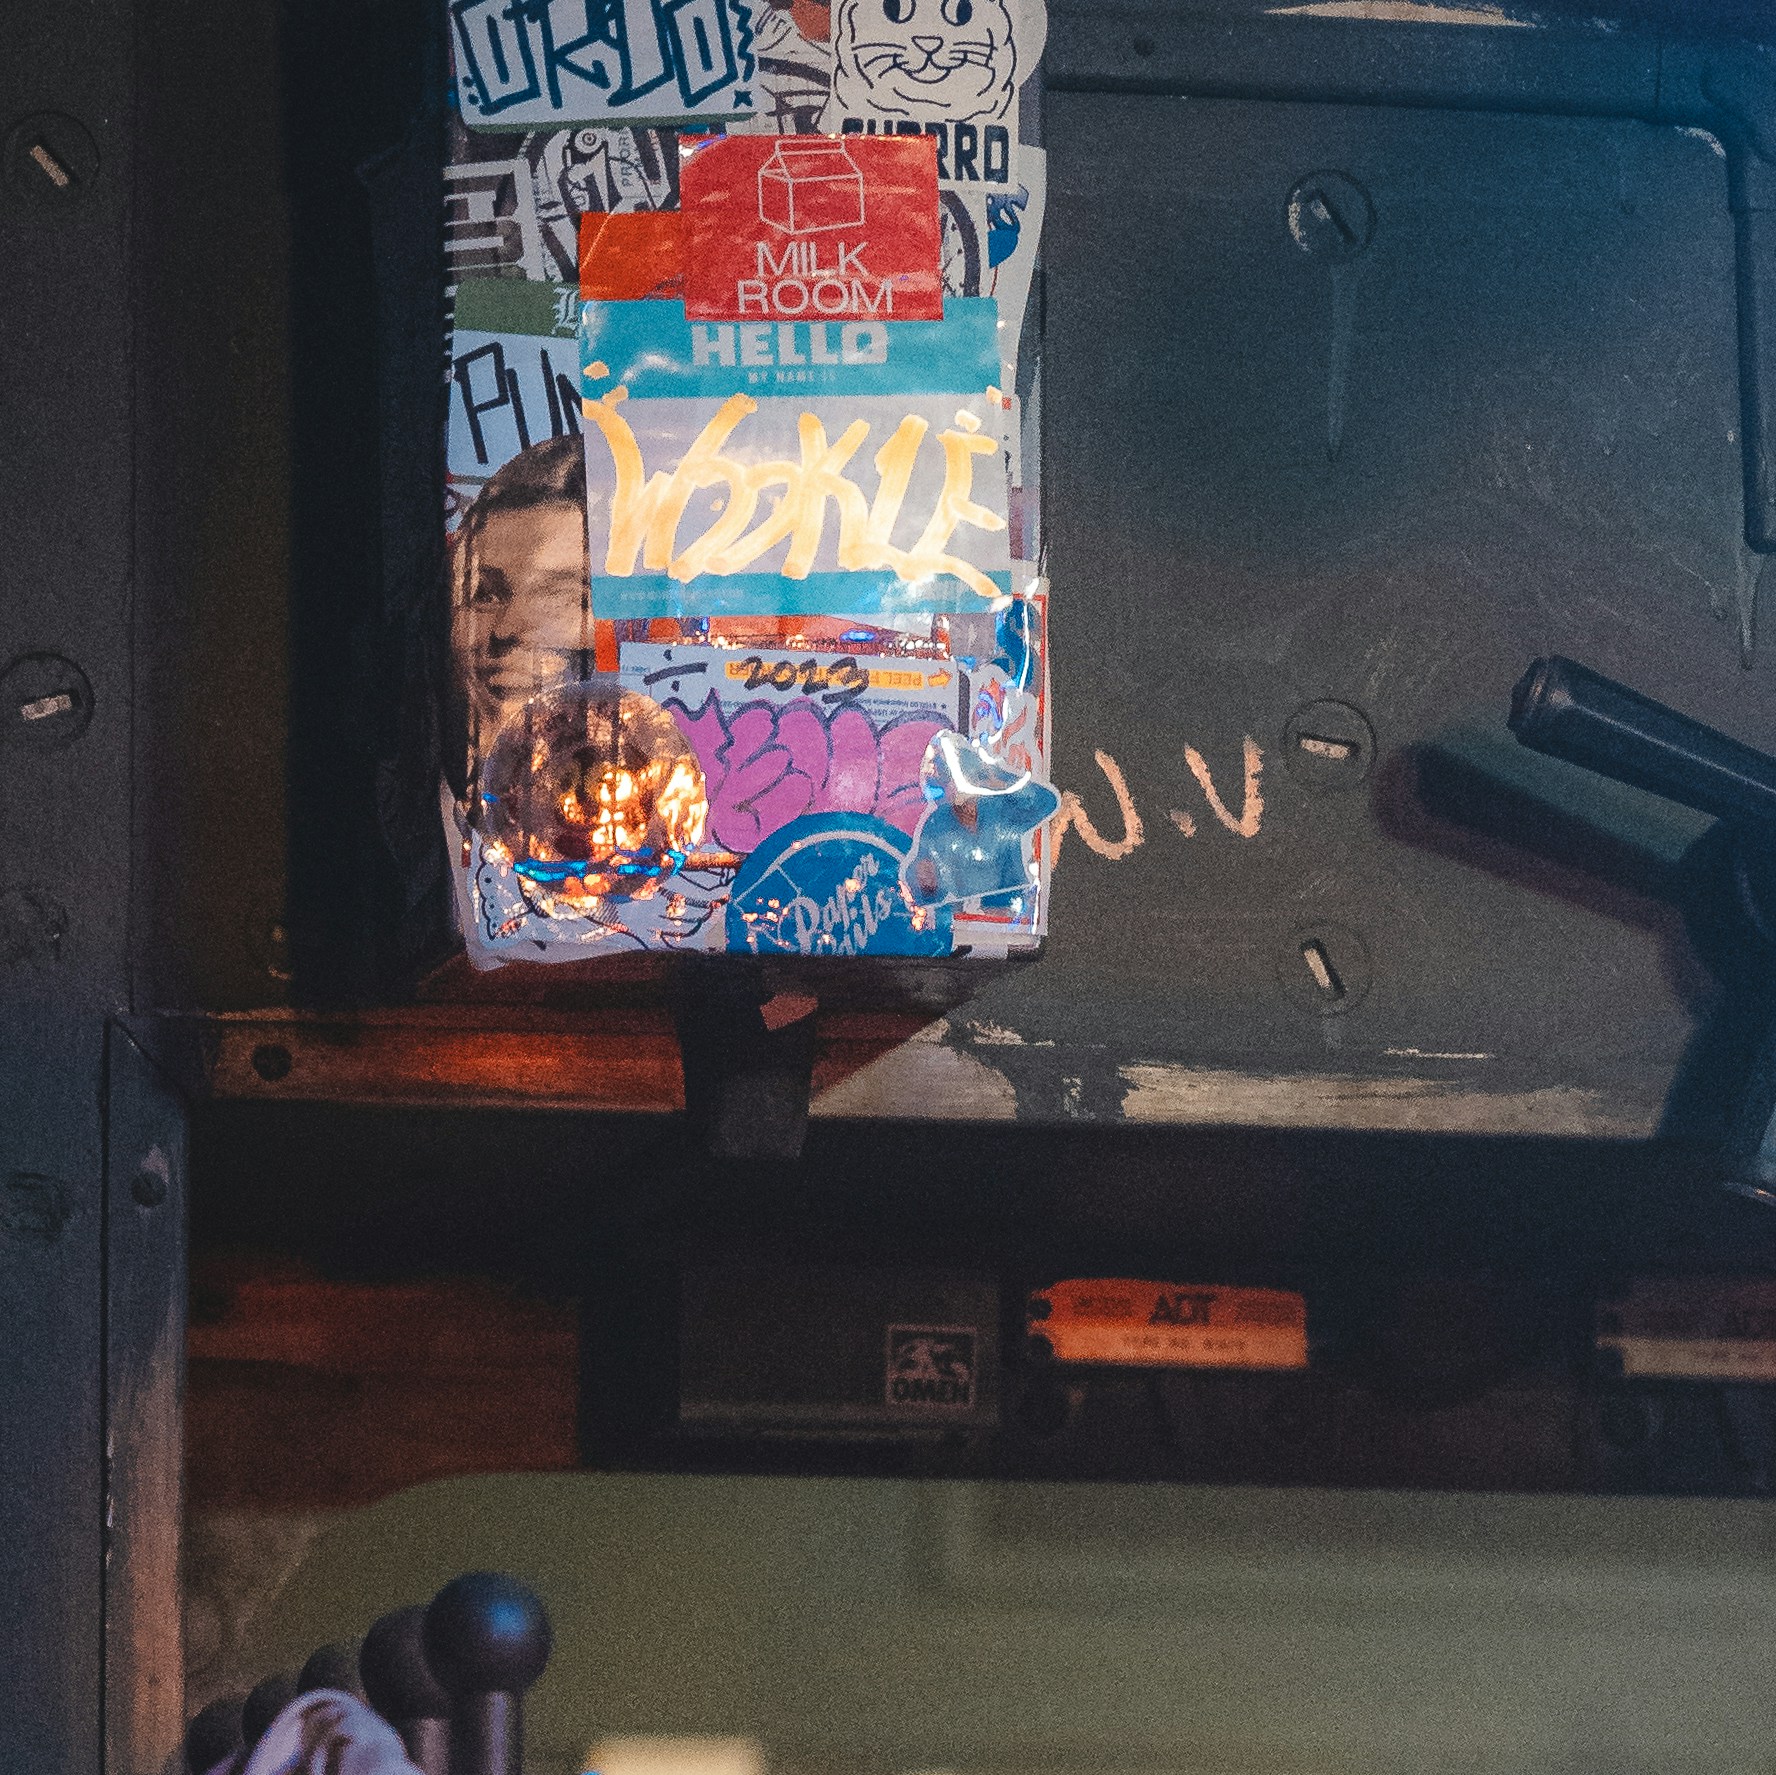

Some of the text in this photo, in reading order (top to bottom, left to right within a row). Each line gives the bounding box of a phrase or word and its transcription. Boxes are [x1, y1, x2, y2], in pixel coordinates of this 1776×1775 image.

[756, 241, 869, 278] MILK
[737, 278, 895, 315] ROOM
[691, 322, 890, 367] HELLO
[748, 371, 768, 384] MY
[776, 370, 814, 383] NAME
[743, 656, 870, 705] 2023
